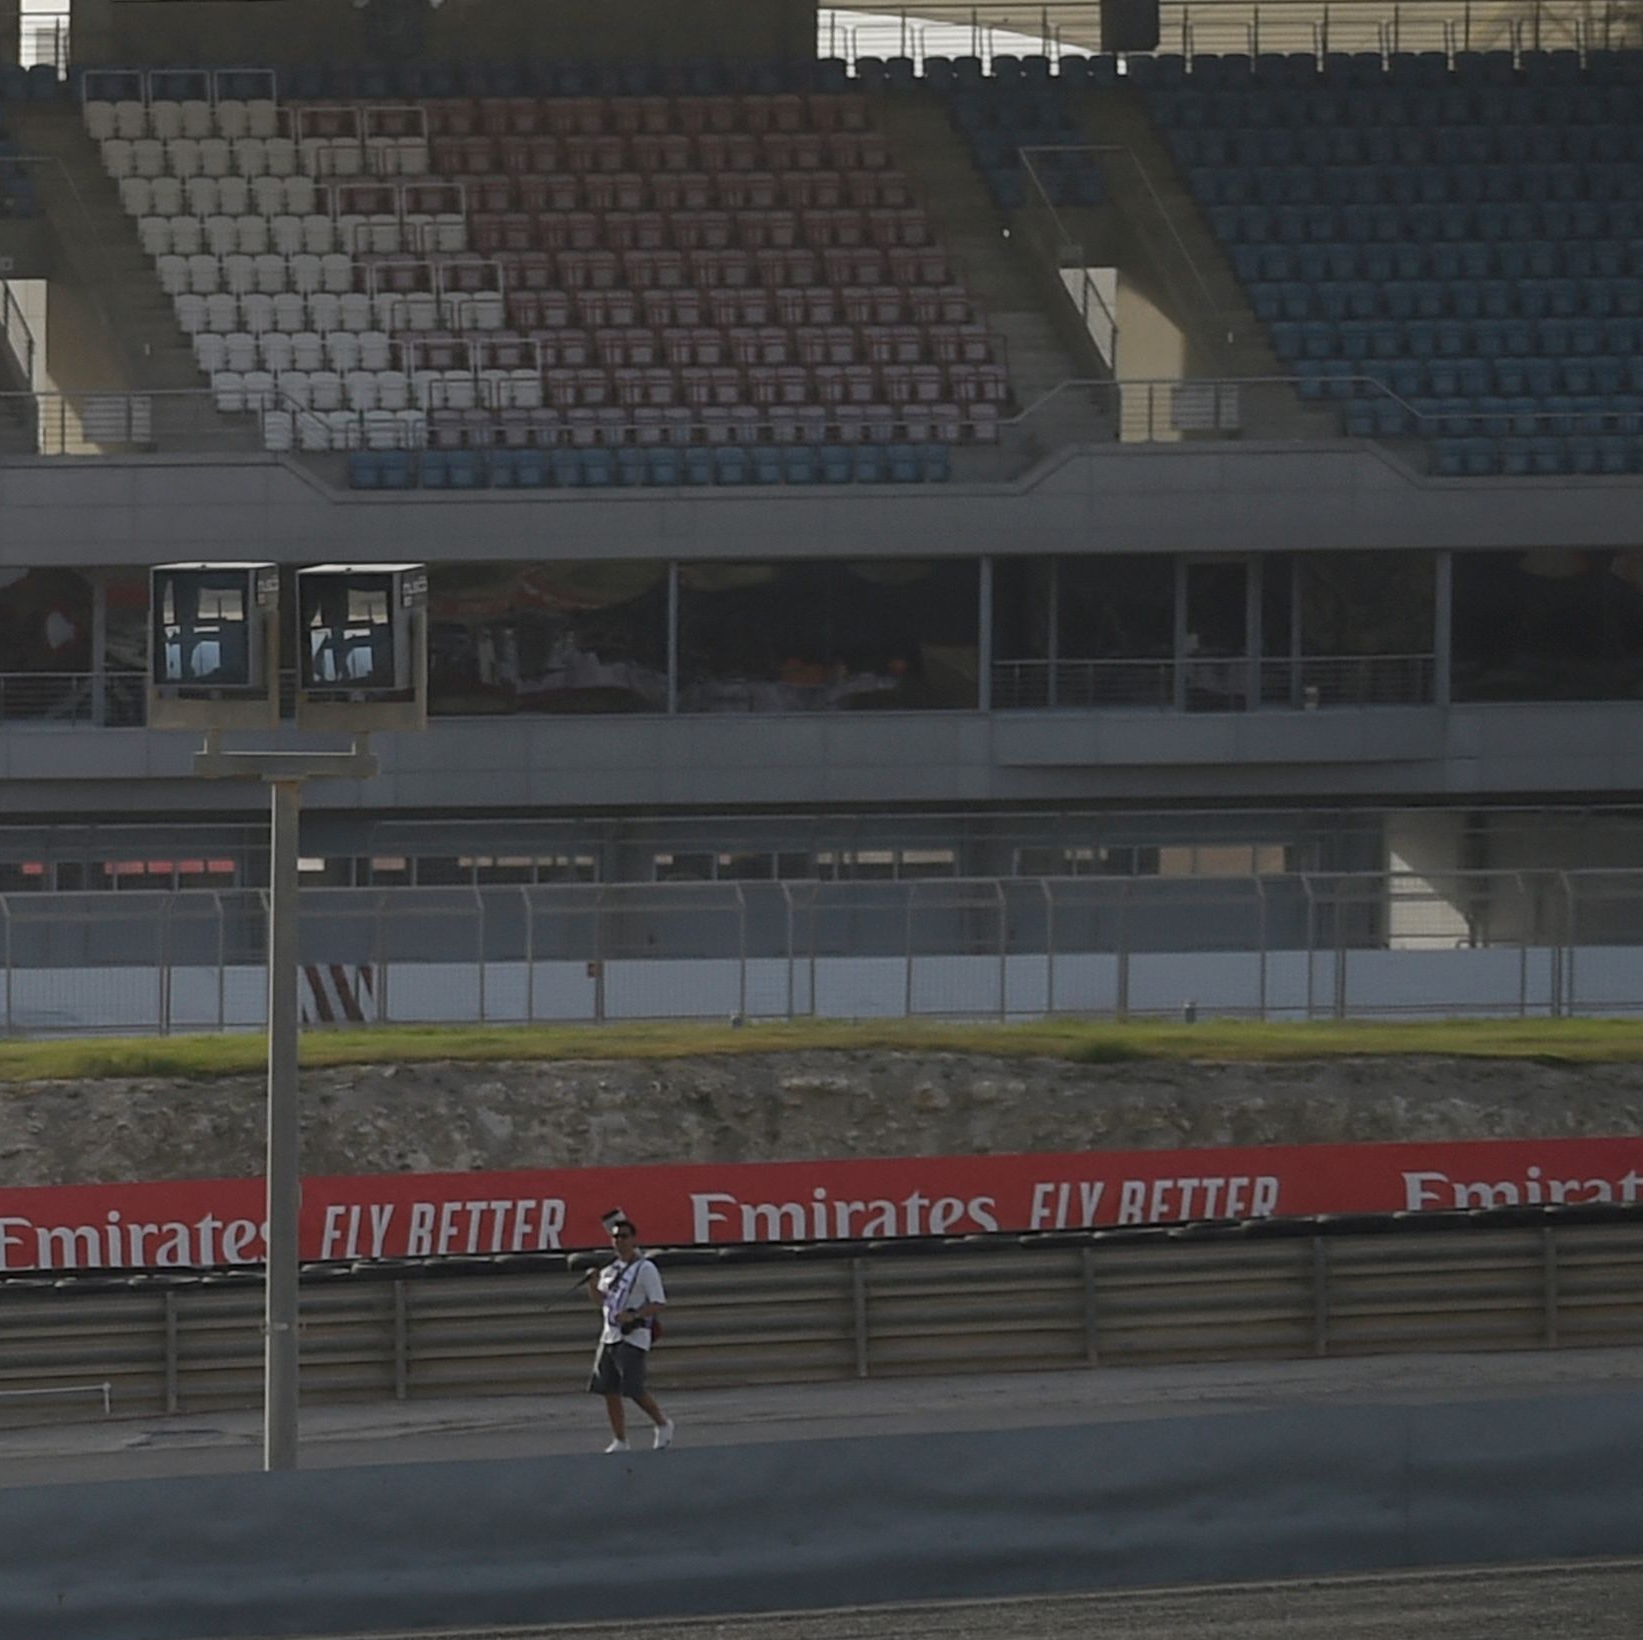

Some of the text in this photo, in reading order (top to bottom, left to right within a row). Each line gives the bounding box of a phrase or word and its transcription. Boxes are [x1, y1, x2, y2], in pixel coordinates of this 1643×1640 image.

[321, 1204, 395, 1259] FLY
[408, 1199, 566, 1256] BETTER
[690, 1176, 1280, 1243] Emirates FLY BETTER
